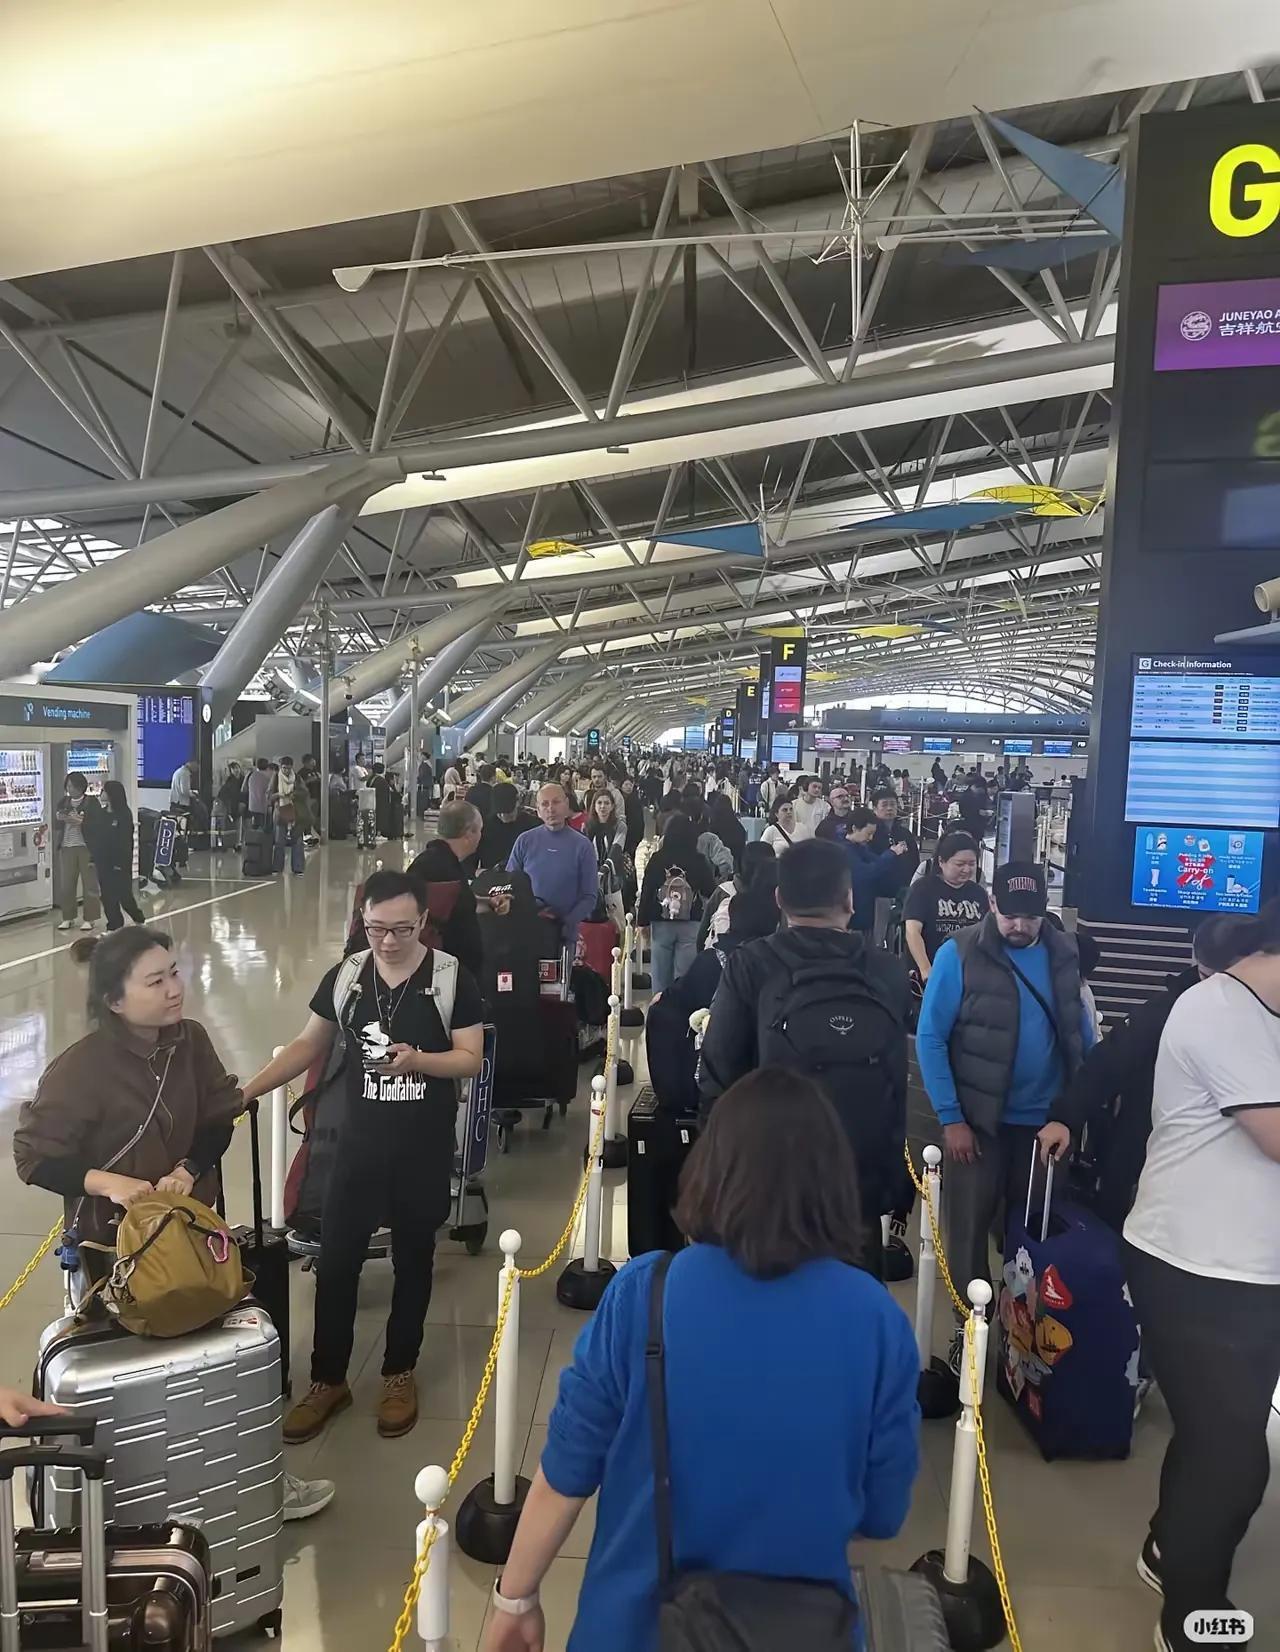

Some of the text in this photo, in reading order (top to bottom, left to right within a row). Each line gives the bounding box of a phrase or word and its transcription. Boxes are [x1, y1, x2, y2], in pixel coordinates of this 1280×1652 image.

[1209, 143, 1280, 238] G
[1219, 310, 1273, 322] JUNEYAO
[783, 643, 795, 660] F
[1153, 660, 1185, 669] Check-in
[1186, 660, 1232, 669] Information
[747, 686, 755, 697] E
[43, 705, 92, 720] Vending machine
[726, 710, 732, 718] D
[159, 828, 172, 856] DHC
[1177, 865, 1214, 875] Carry-on
[361, 1071, 427, 1102] The Godfather
[475, 1057, 491, 1142] DHC
